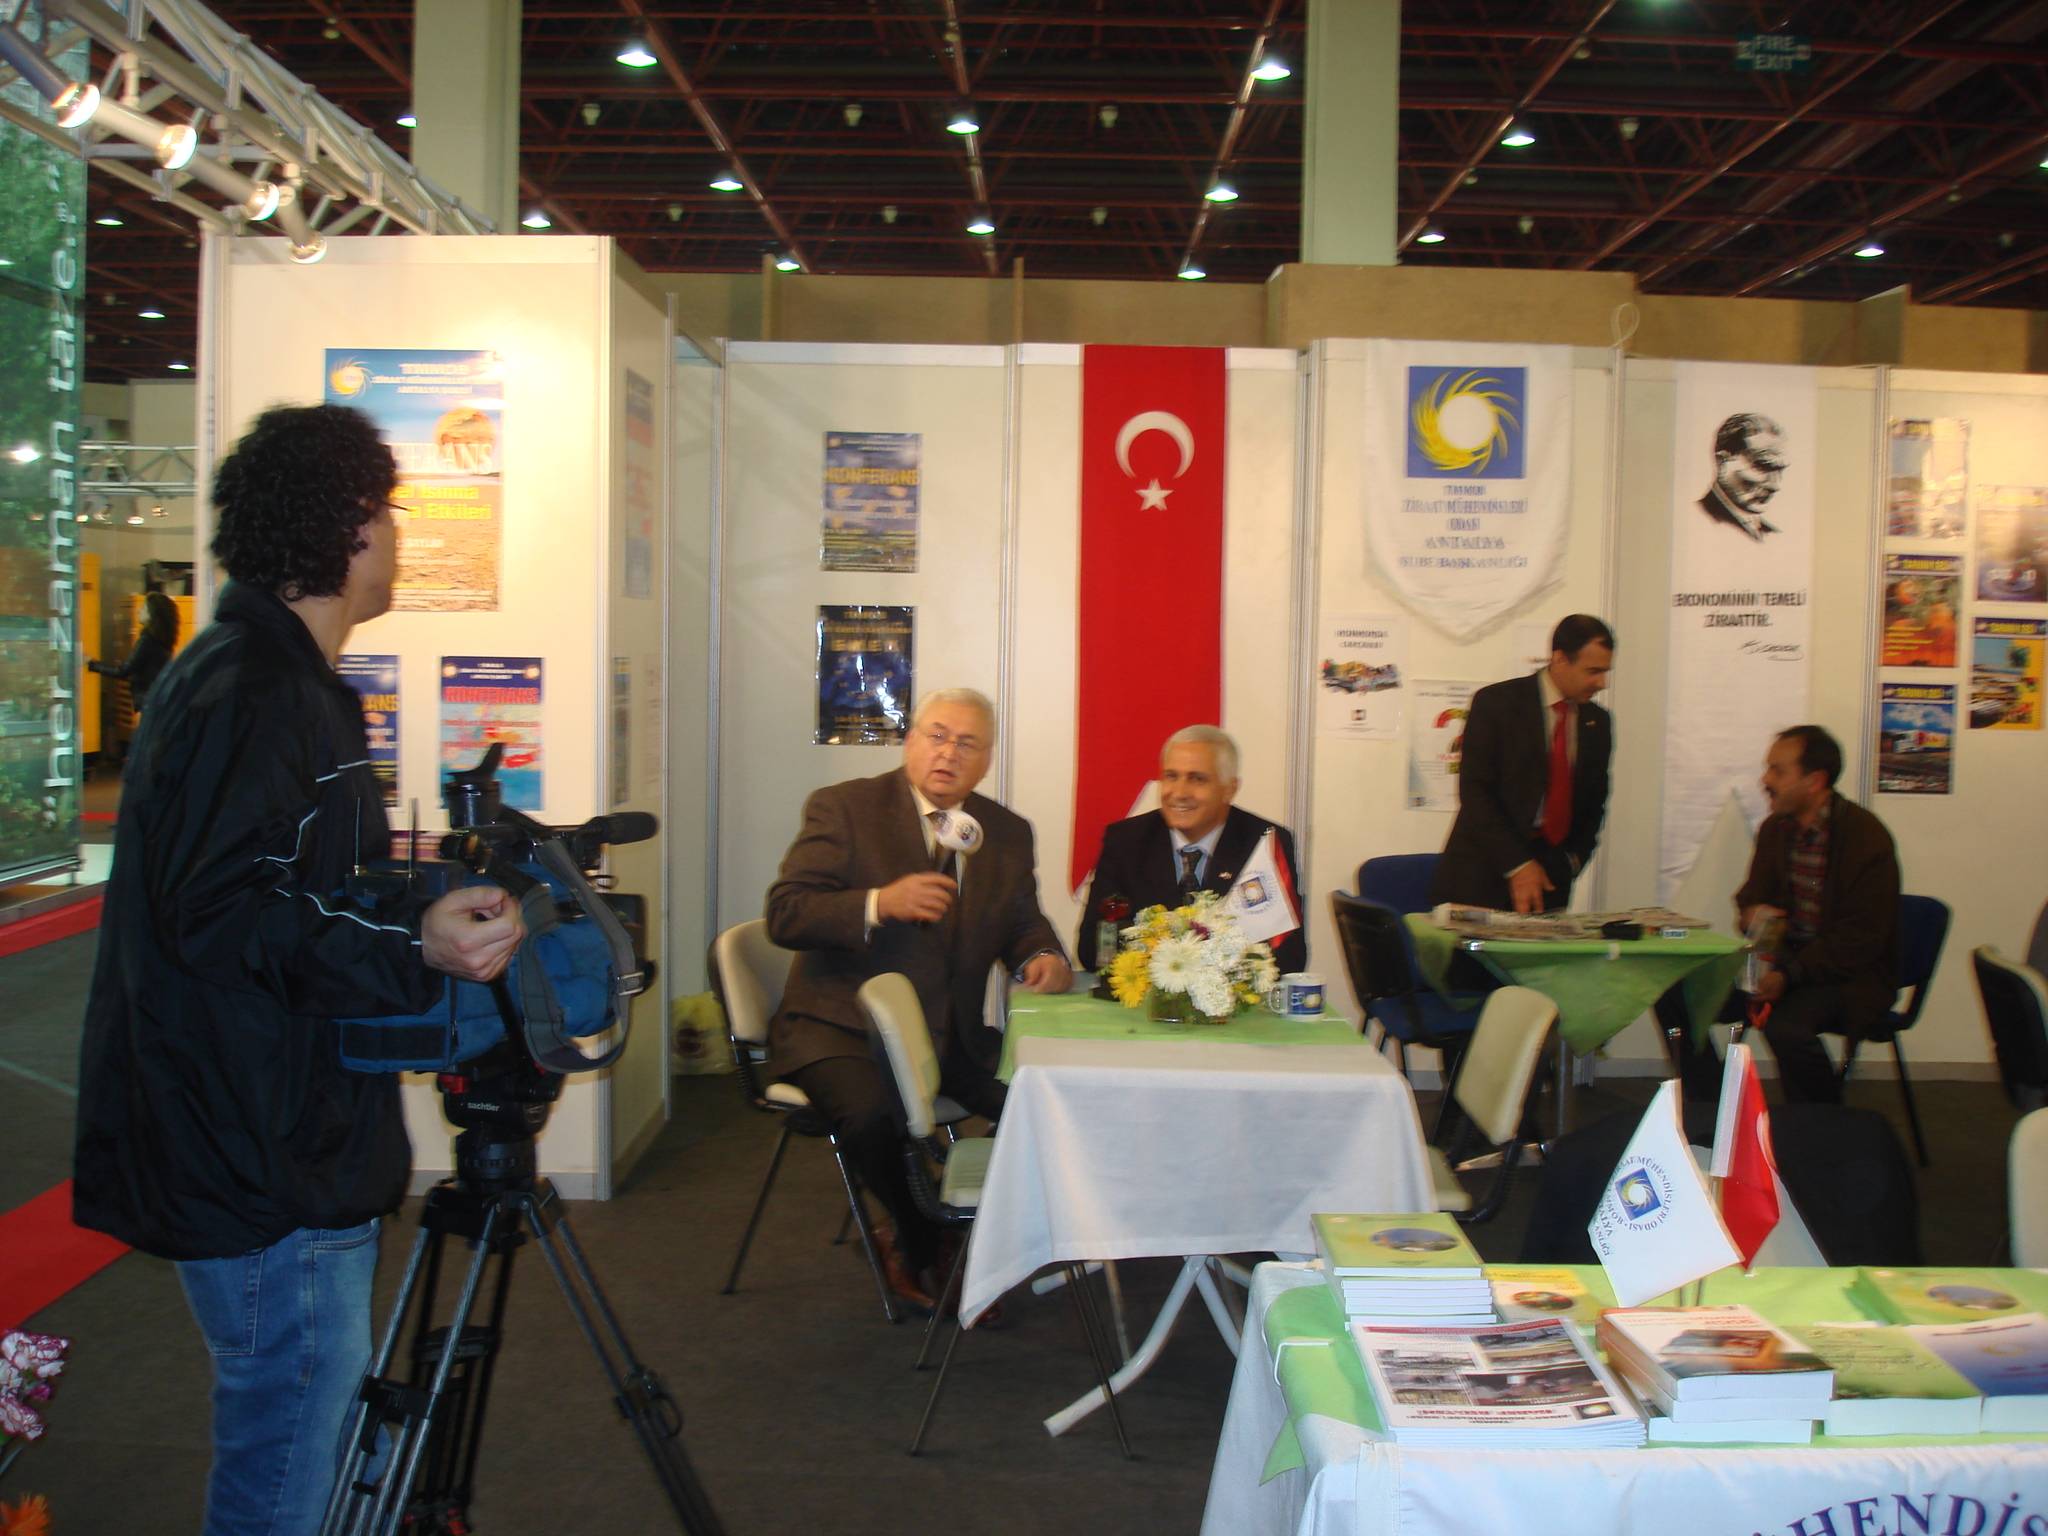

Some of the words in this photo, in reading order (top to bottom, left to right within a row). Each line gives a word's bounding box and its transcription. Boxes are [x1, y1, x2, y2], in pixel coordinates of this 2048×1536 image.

[1755, 35, 1794, 49] FIRE
[1754, 54, 1793, 70] EXIT
[49, 421, 74, 652] zaman
[467, 1102, 500, 1111] sachtler
